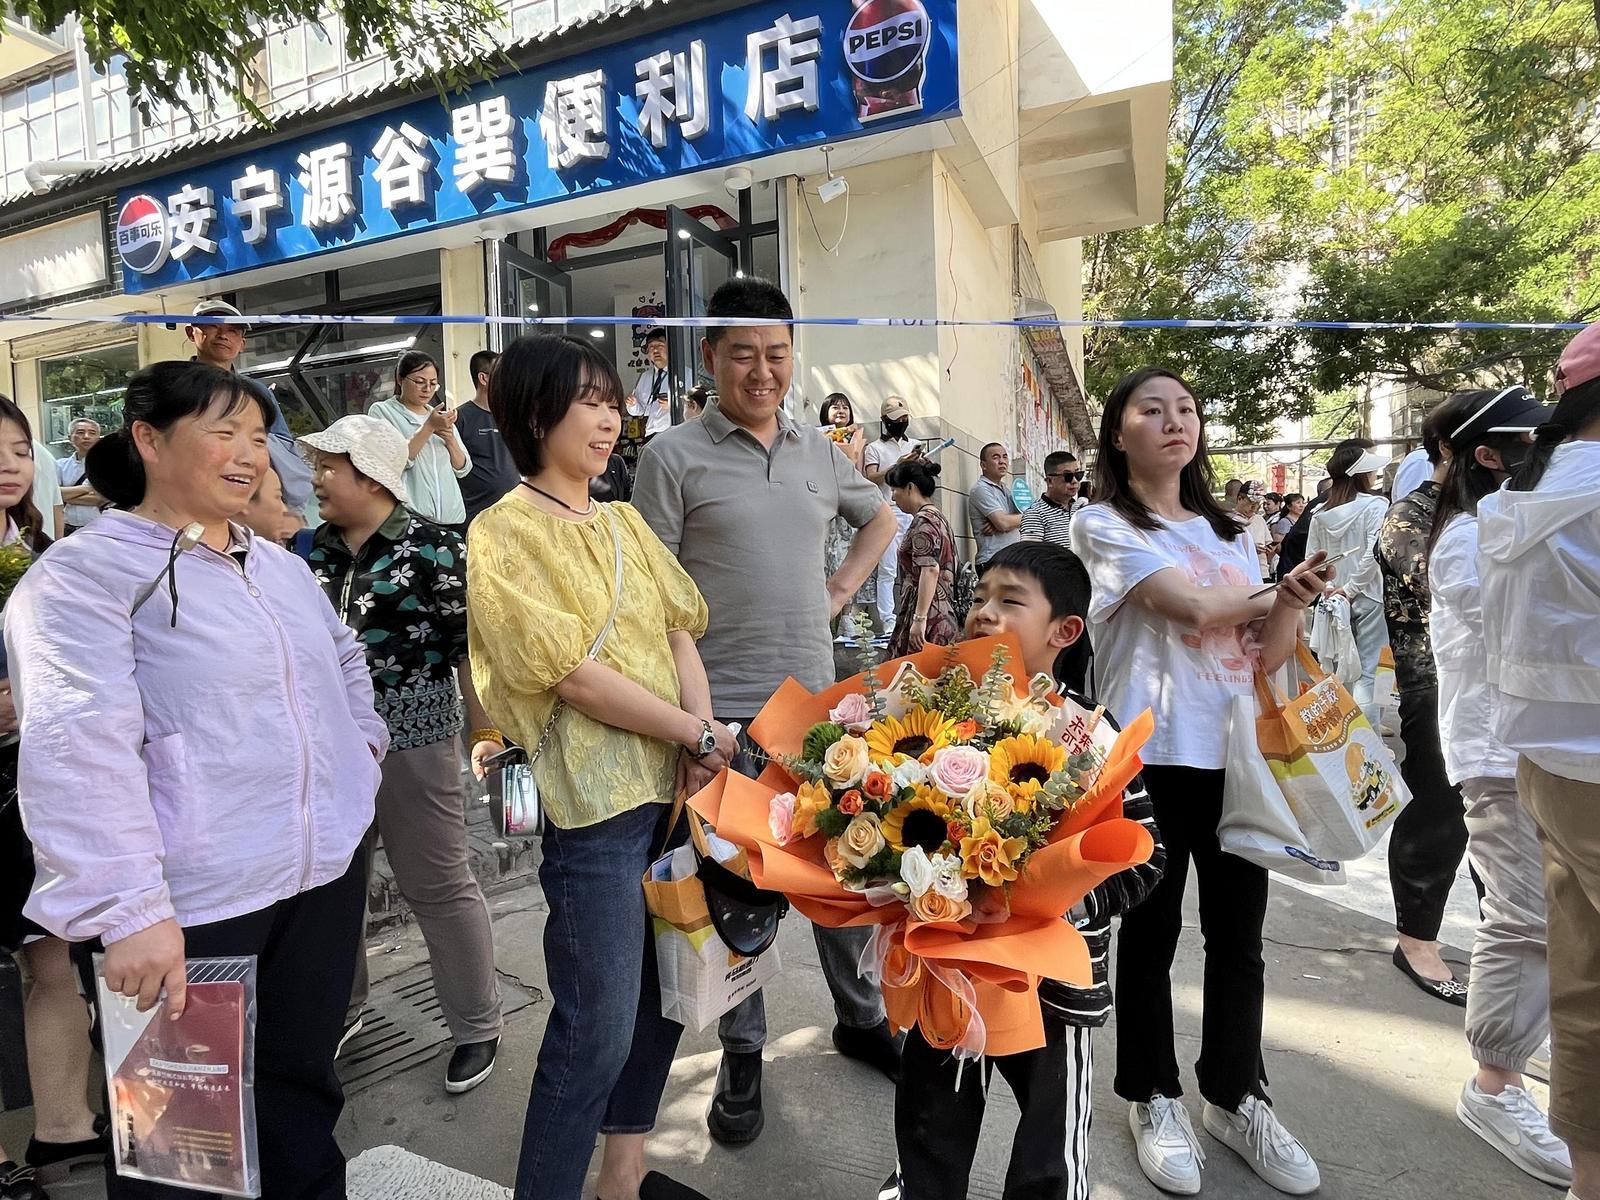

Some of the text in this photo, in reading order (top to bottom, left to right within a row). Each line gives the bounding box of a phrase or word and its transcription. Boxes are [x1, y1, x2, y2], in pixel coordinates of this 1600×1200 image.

[849, 17, 922, 54] PEPSI
[167, 13, 823, 262] 安宁源谷巽便利店
[119, 220, 163, 246] 百事可乐
